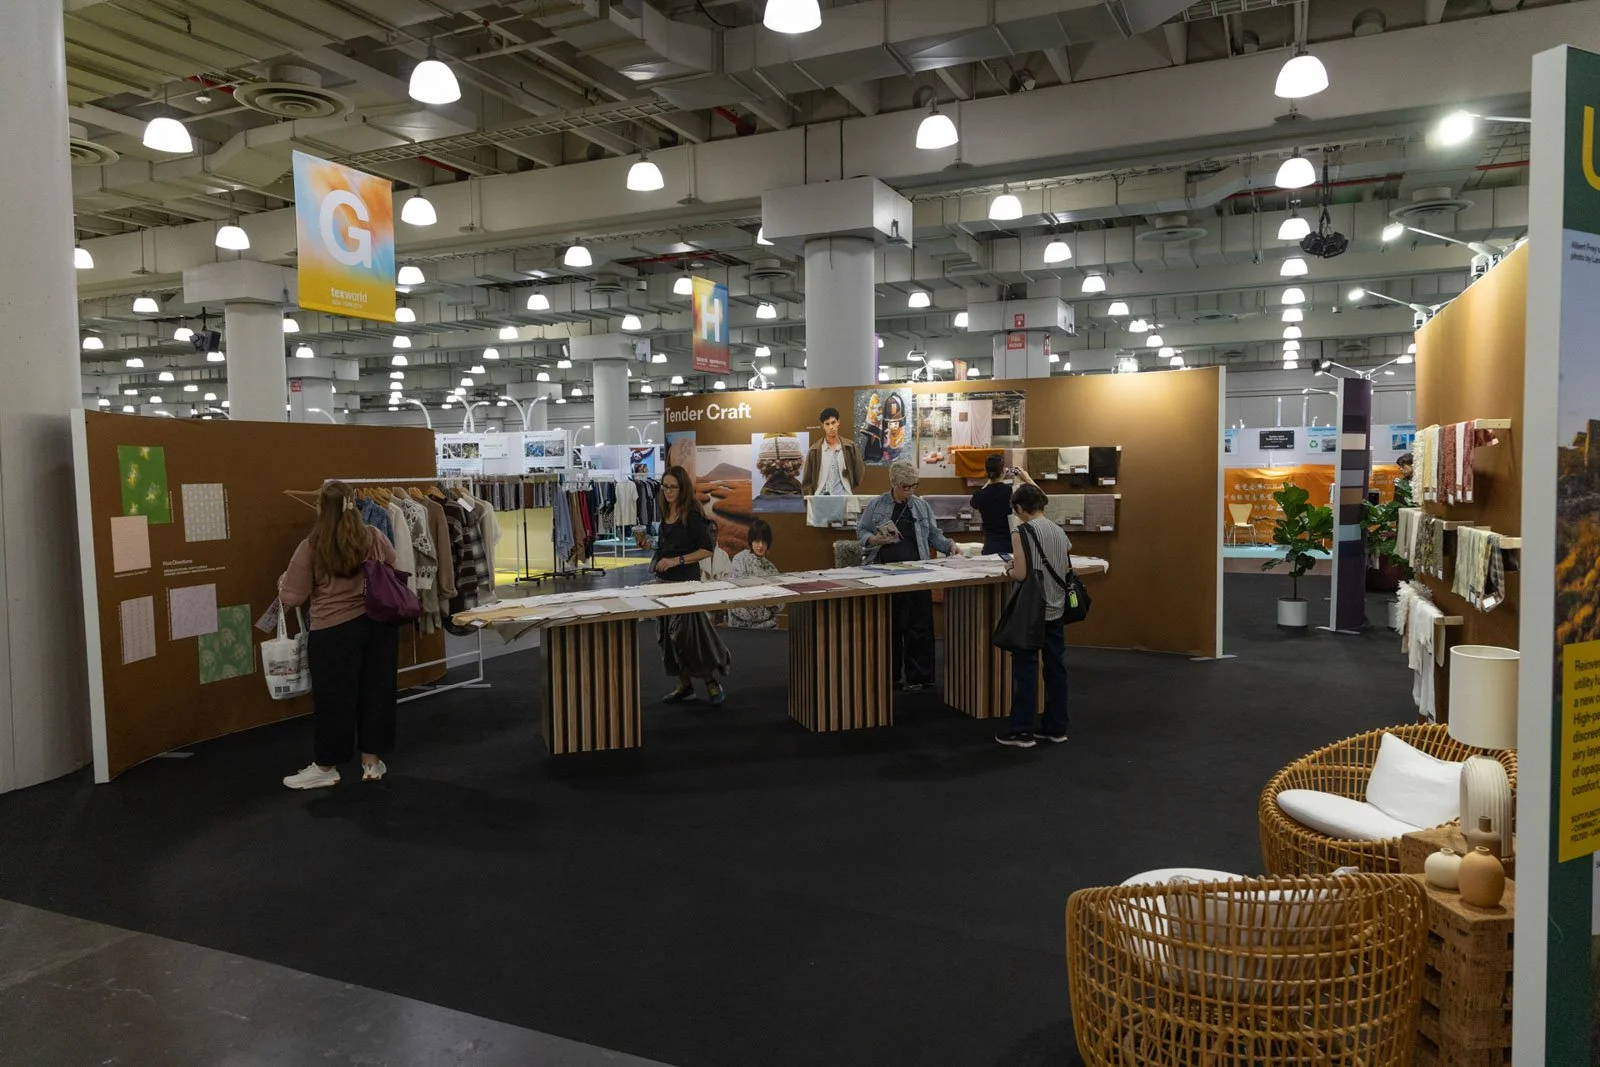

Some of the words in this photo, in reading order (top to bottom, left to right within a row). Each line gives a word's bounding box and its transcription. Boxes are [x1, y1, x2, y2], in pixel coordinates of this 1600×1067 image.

[319, 189, 372, 269] G
[330, 287, 368, 303] texworld
[701, 295, 720, 342] H
[665, 406, 704, 423] Tender
[706, 401, 752, 421] Craft
